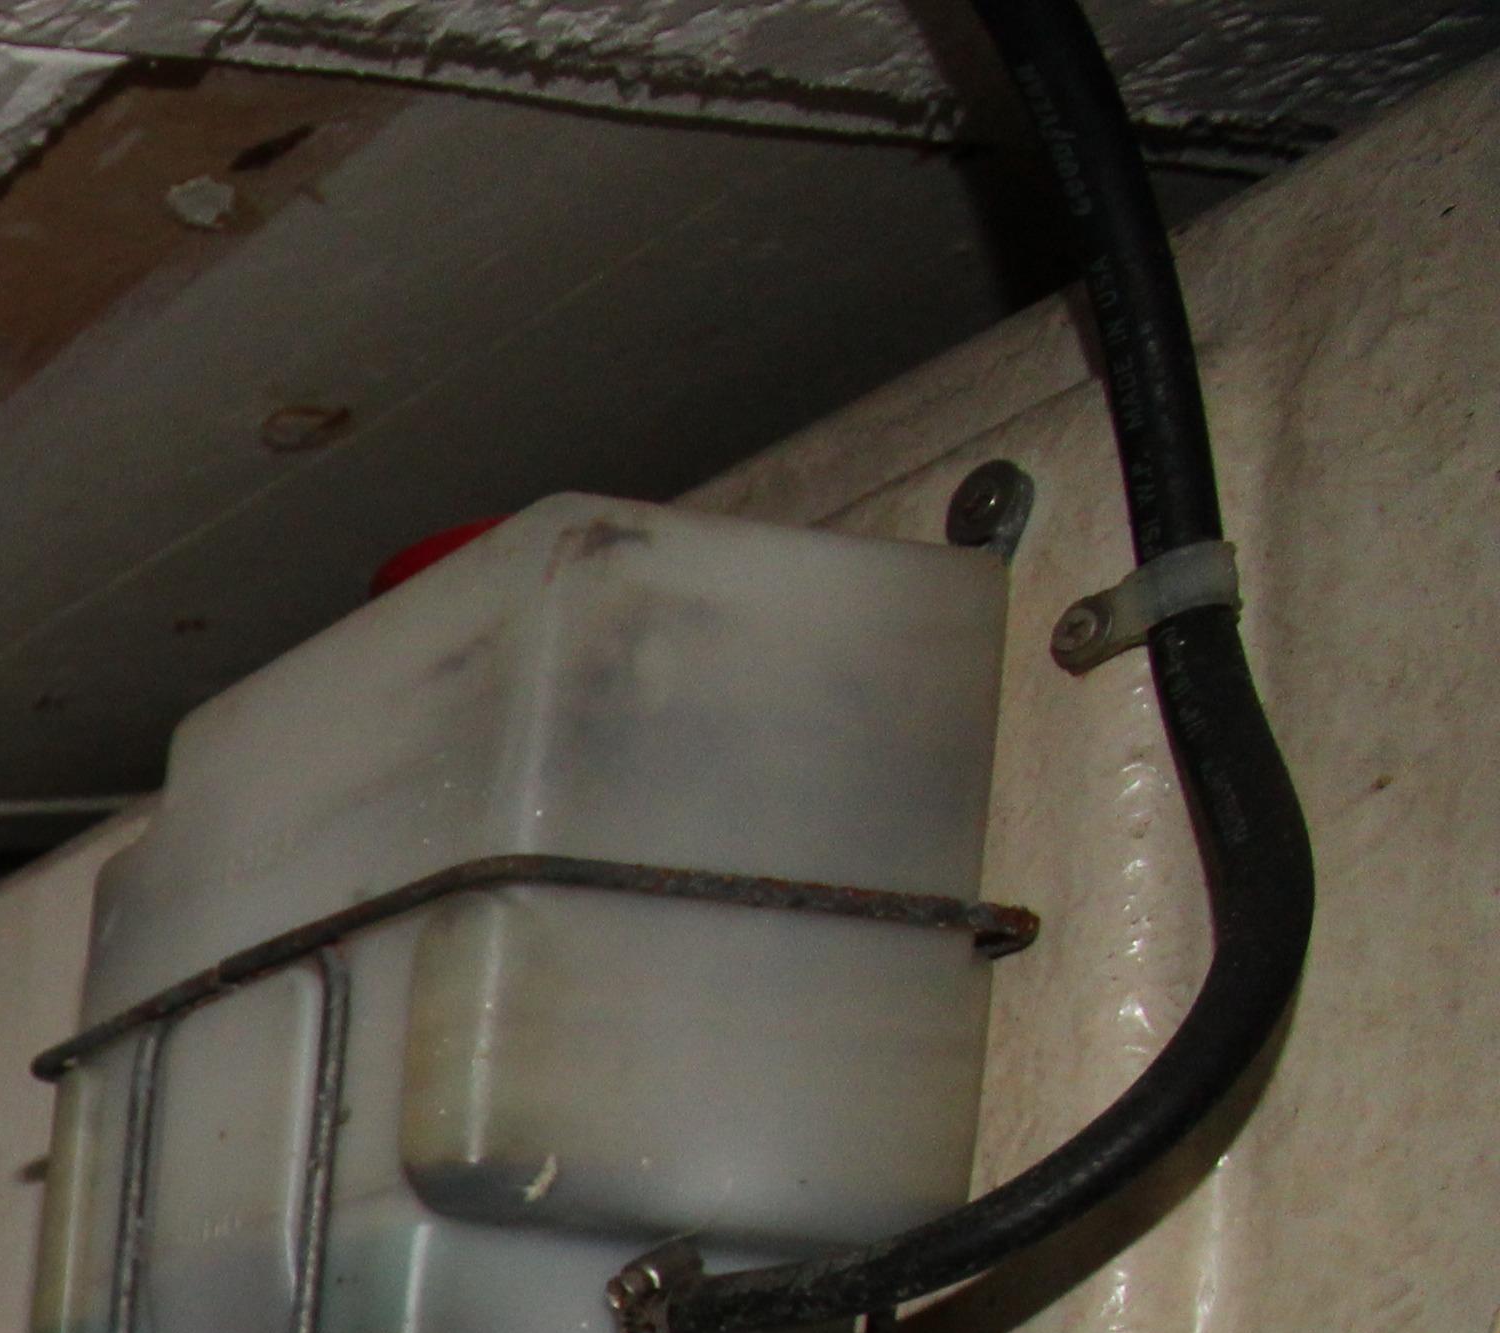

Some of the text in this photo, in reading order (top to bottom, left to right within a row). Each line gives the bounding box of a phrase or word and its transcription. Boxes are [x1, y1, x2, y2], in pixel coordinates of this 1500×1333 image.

[1088, 254, 1118, 306] USA
[1103, 316, 1128, 345] IN
[1113, 355, 1145, 431] MADE
